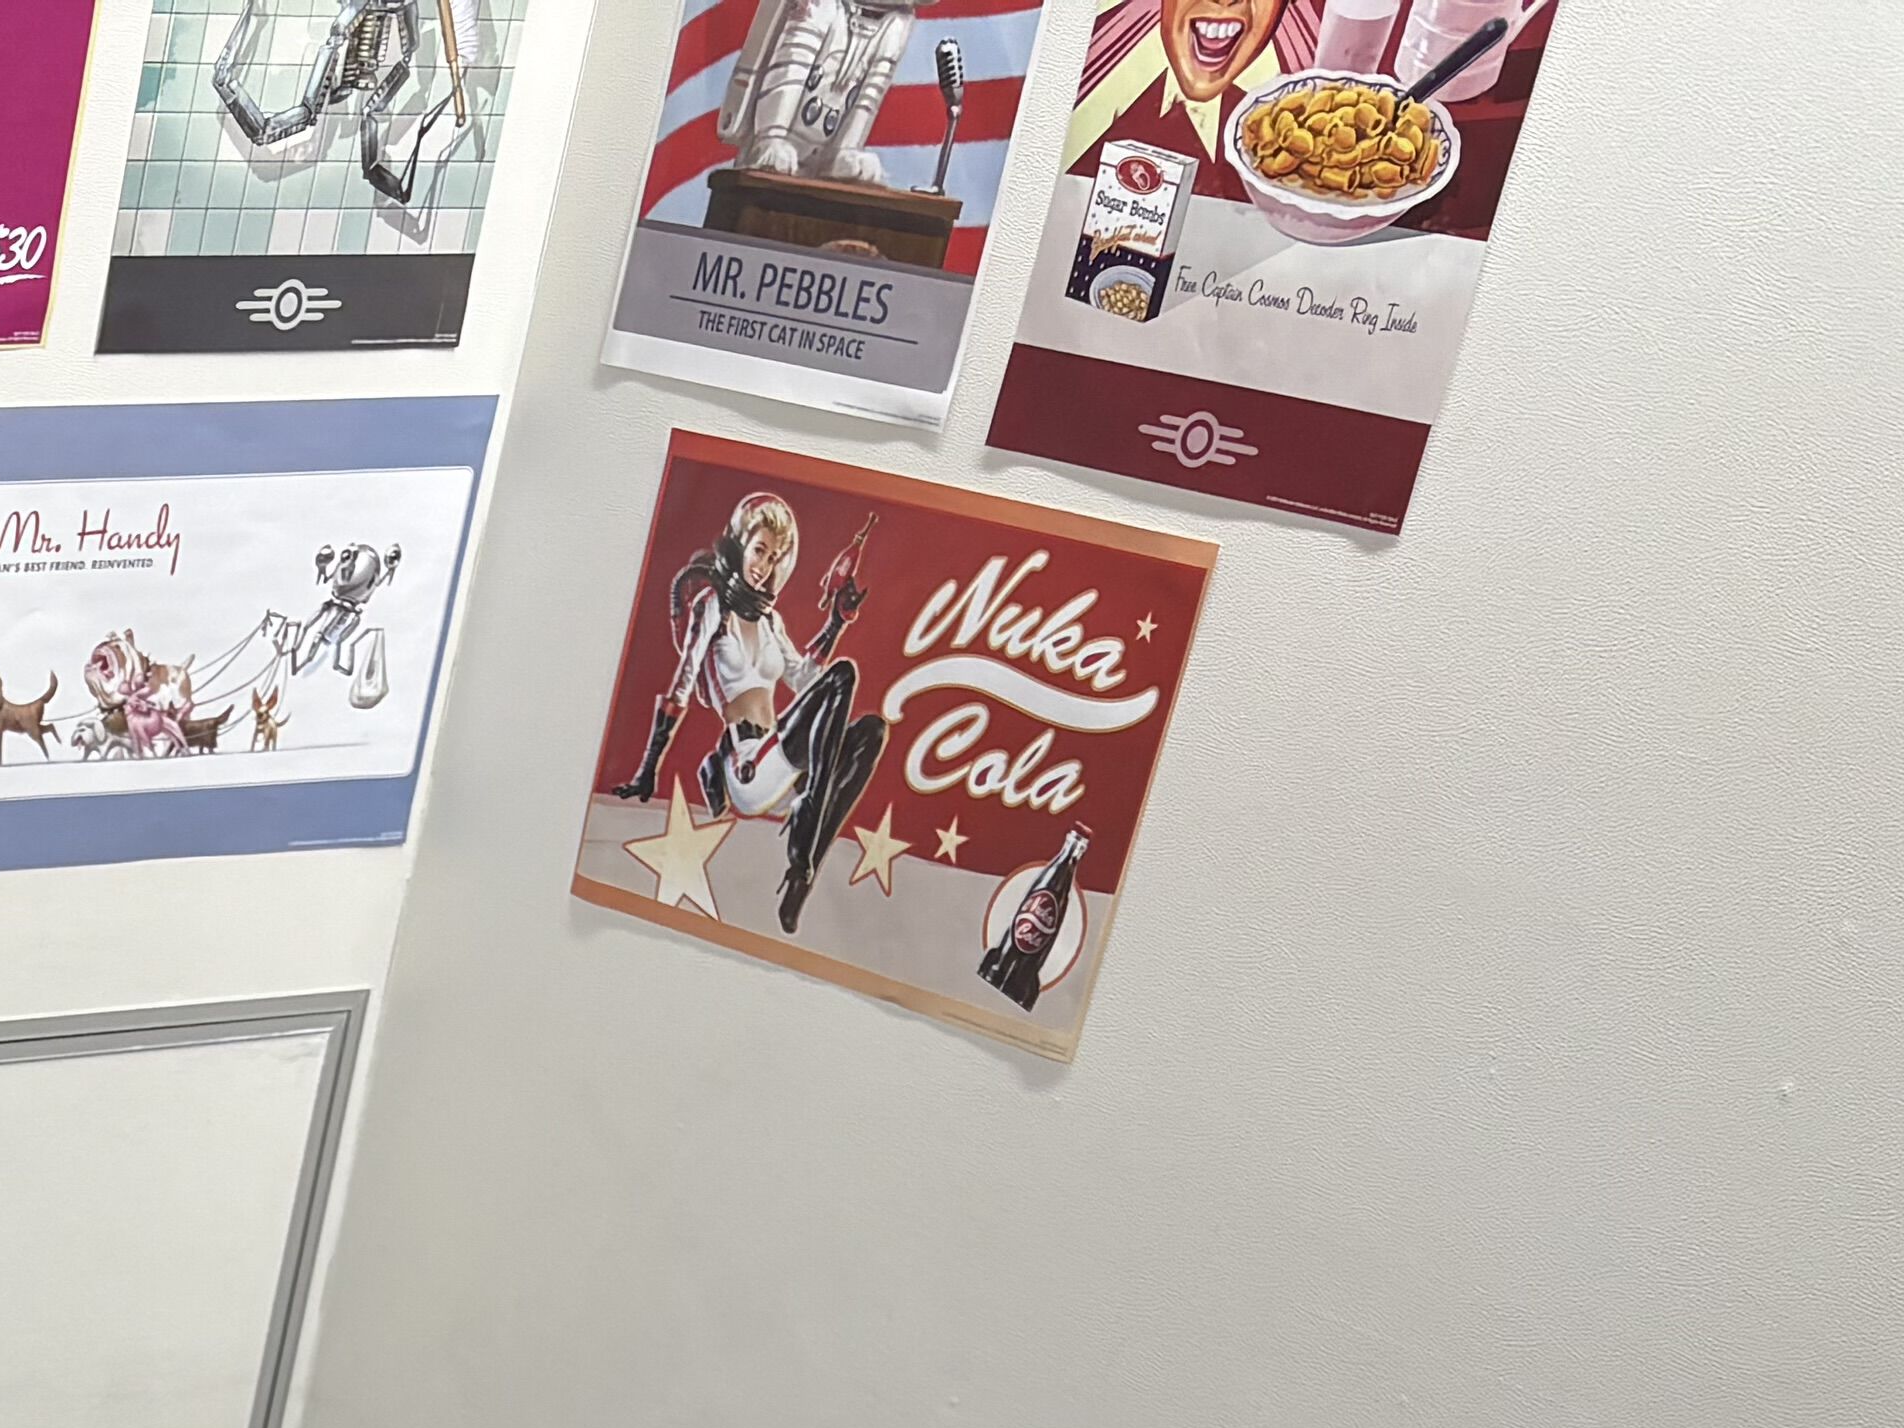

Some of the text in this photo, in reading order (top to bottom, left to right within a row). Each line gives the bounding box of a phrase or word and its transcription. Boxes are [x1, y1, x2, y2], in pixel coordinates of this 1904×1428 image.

[1095, 190, 1166, 226] Sugar Bombs
[692, 251, 894, 325] MR. PEBBLES
[1175, 265, 1418, 336] Free Captain Cosmos Decoder Ring Inside
[698, 309, 866, 360] THE FIRST CAT IN SPACE
[23, 561, 47, 572] BEST
[77, 502, 181, 576] Handy
[903, 547, 1128, 692] Nuka
[904, 703, 1086, 816] Cola
